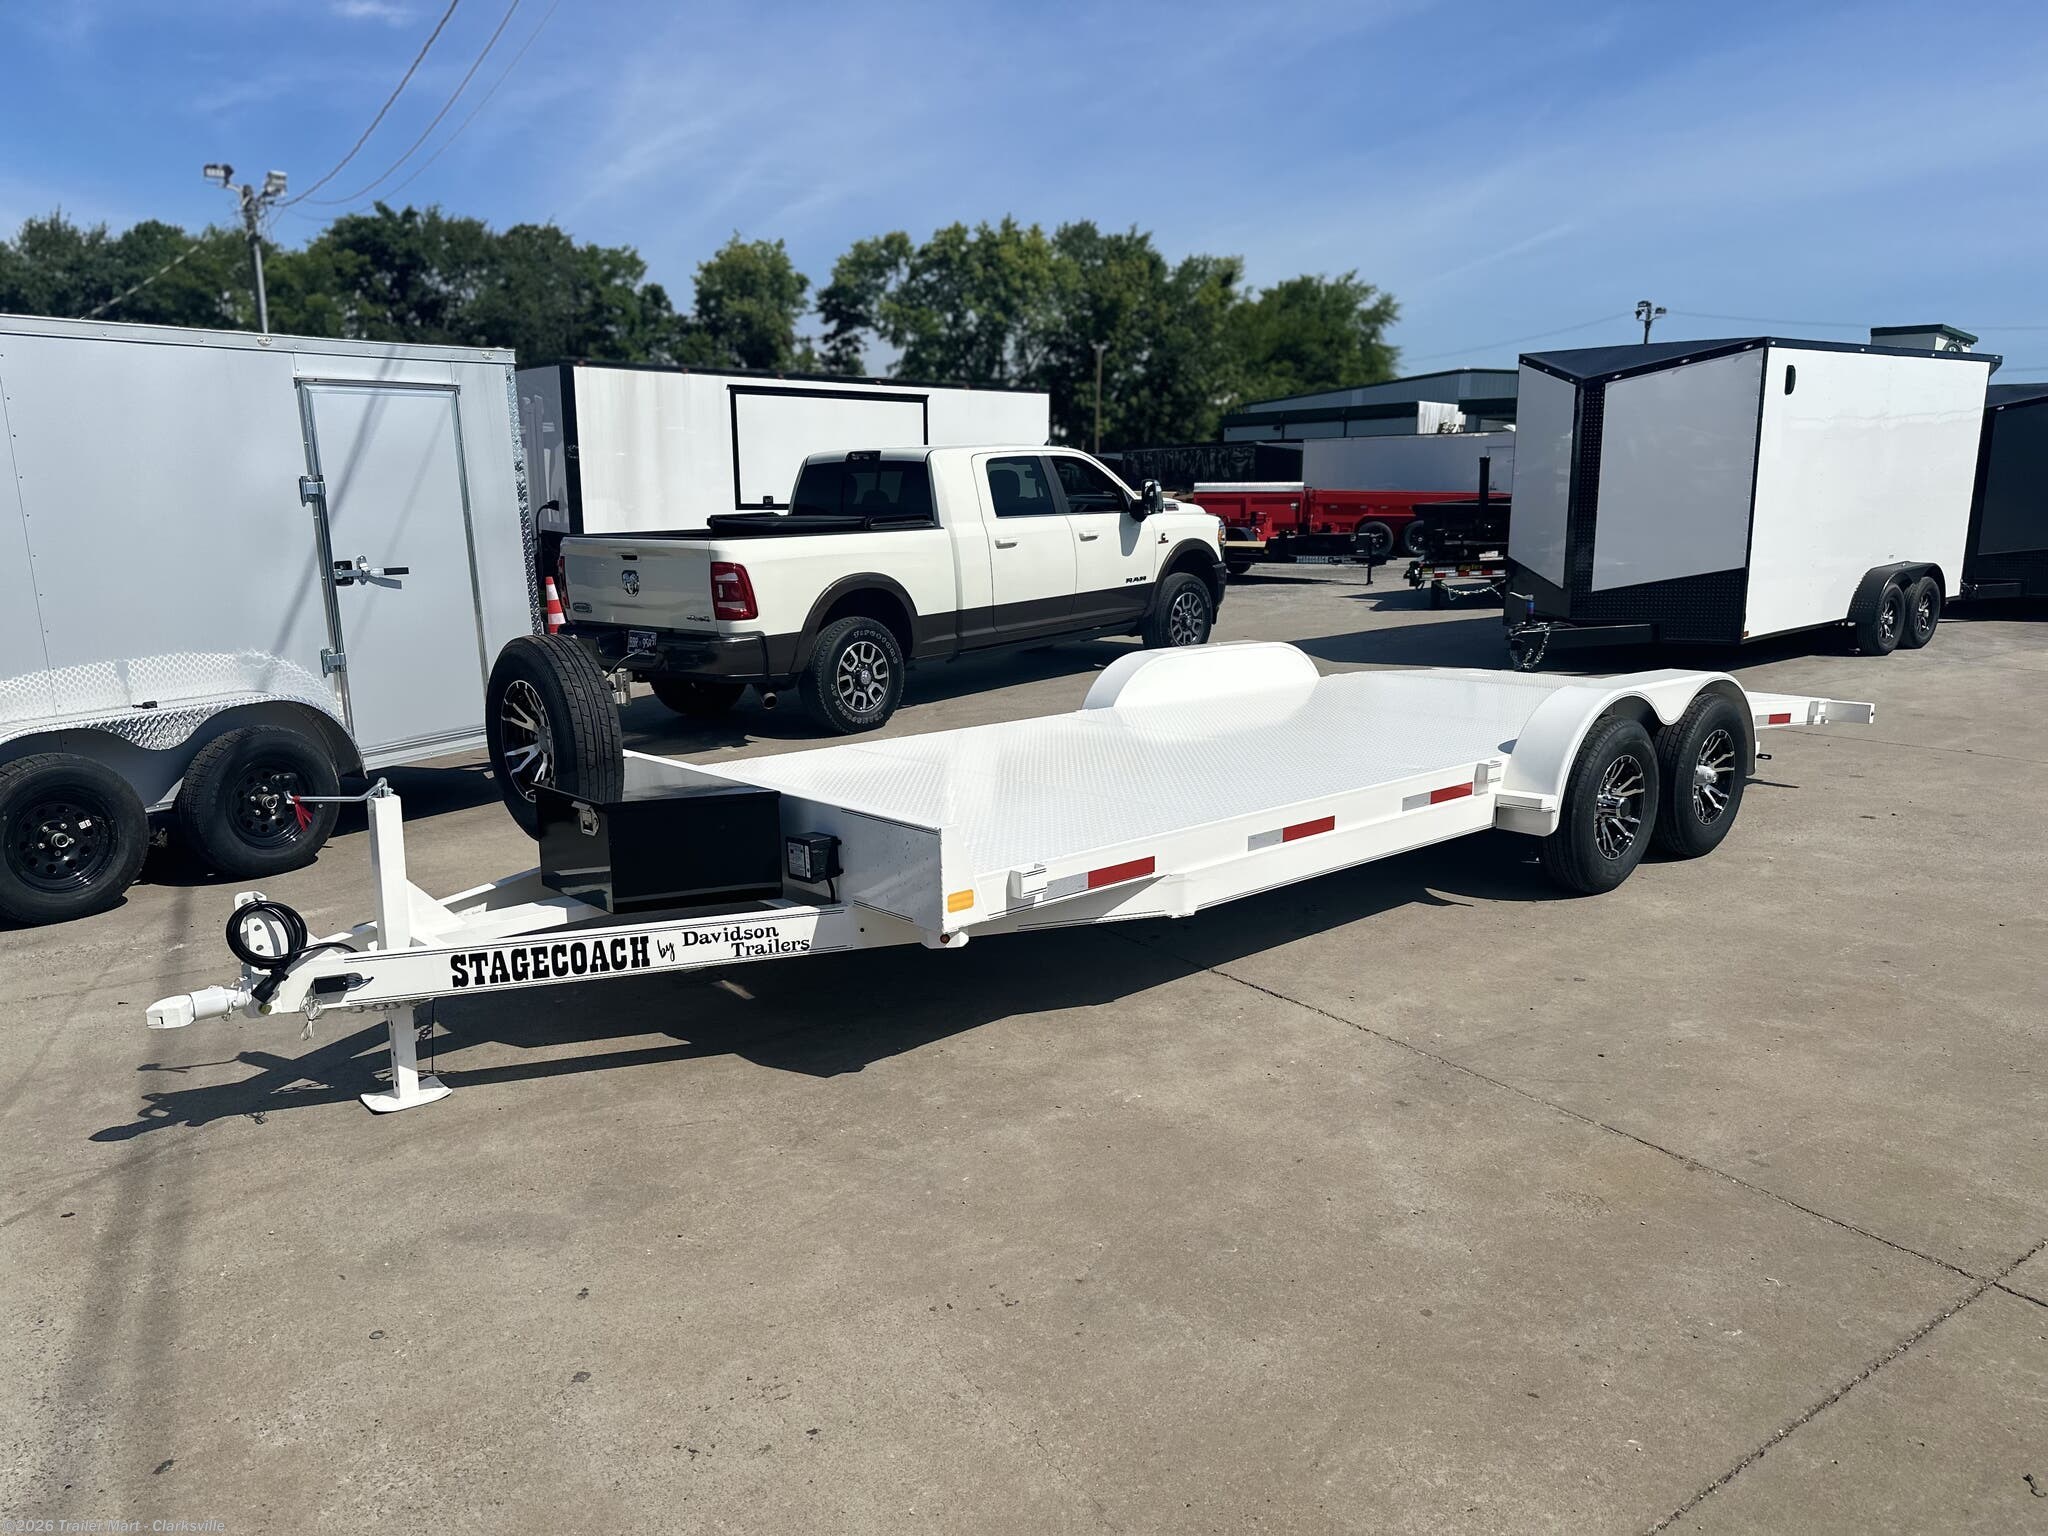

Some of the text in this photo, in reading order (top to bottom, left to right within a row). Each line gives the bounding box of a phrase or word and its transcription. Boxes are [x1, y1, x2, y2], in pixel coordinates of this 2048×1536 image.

[1125, 575, 1147, 584] RAM
[450, 926, 780, 988] STAGECOACH by Davidson
[730, 938, 811, 958] Trailers
